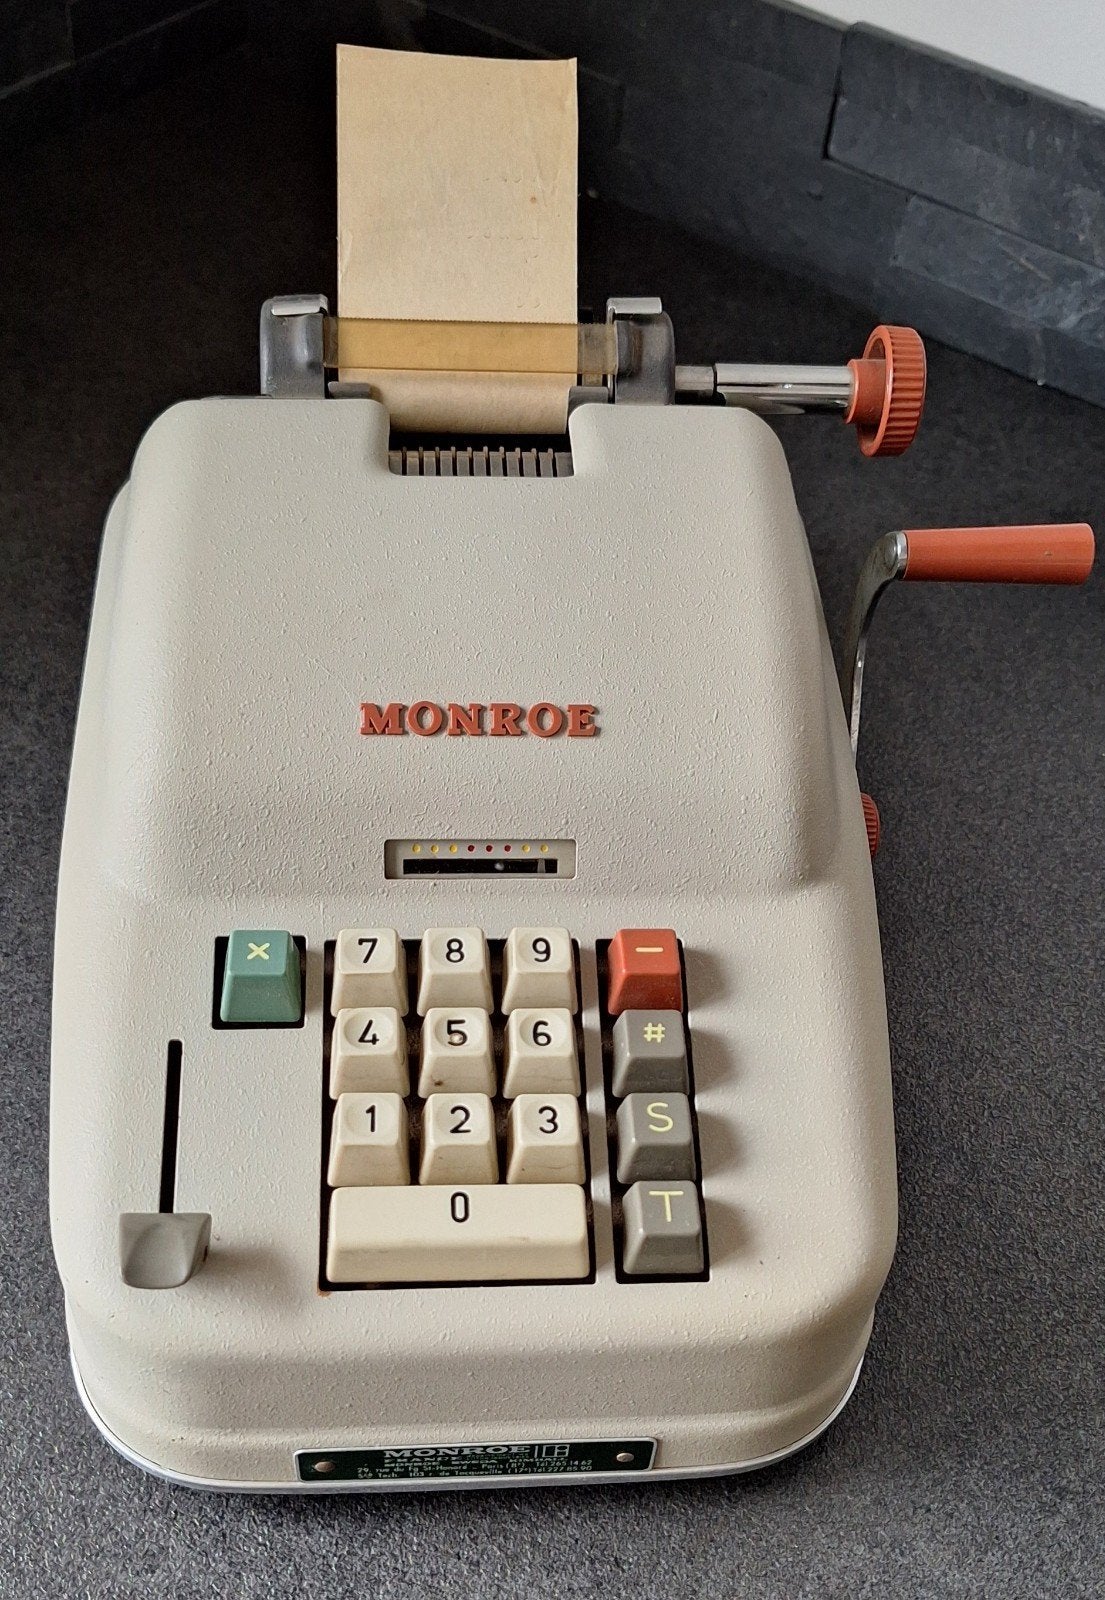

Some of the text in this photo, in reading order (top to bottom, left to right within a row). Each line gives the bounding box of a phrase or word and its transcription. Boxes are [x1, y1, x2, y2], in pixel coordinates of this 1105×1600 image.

[359, 700, 601, 737] MONROE
[357, 937, 378, 964] 7
[445, 938, 465, 963] 8
[532, 937, 551, 963] 9
[357, 1019, 380, 1046] 4
[446, 1019, 468, 1047] 5
[532, 1020, 552, 1047] 6
[365, 1104, 376, 1133] 1
[449, 1105, 471, 1134] 2
[538, 1105, 559, 1134] 3
[646, 1102, 674, 1133] S
[450, 1191, 470, 1223] 0
[648, 1190, 685, 1223] T
[384, 1446, 531, 1457] MONROE
